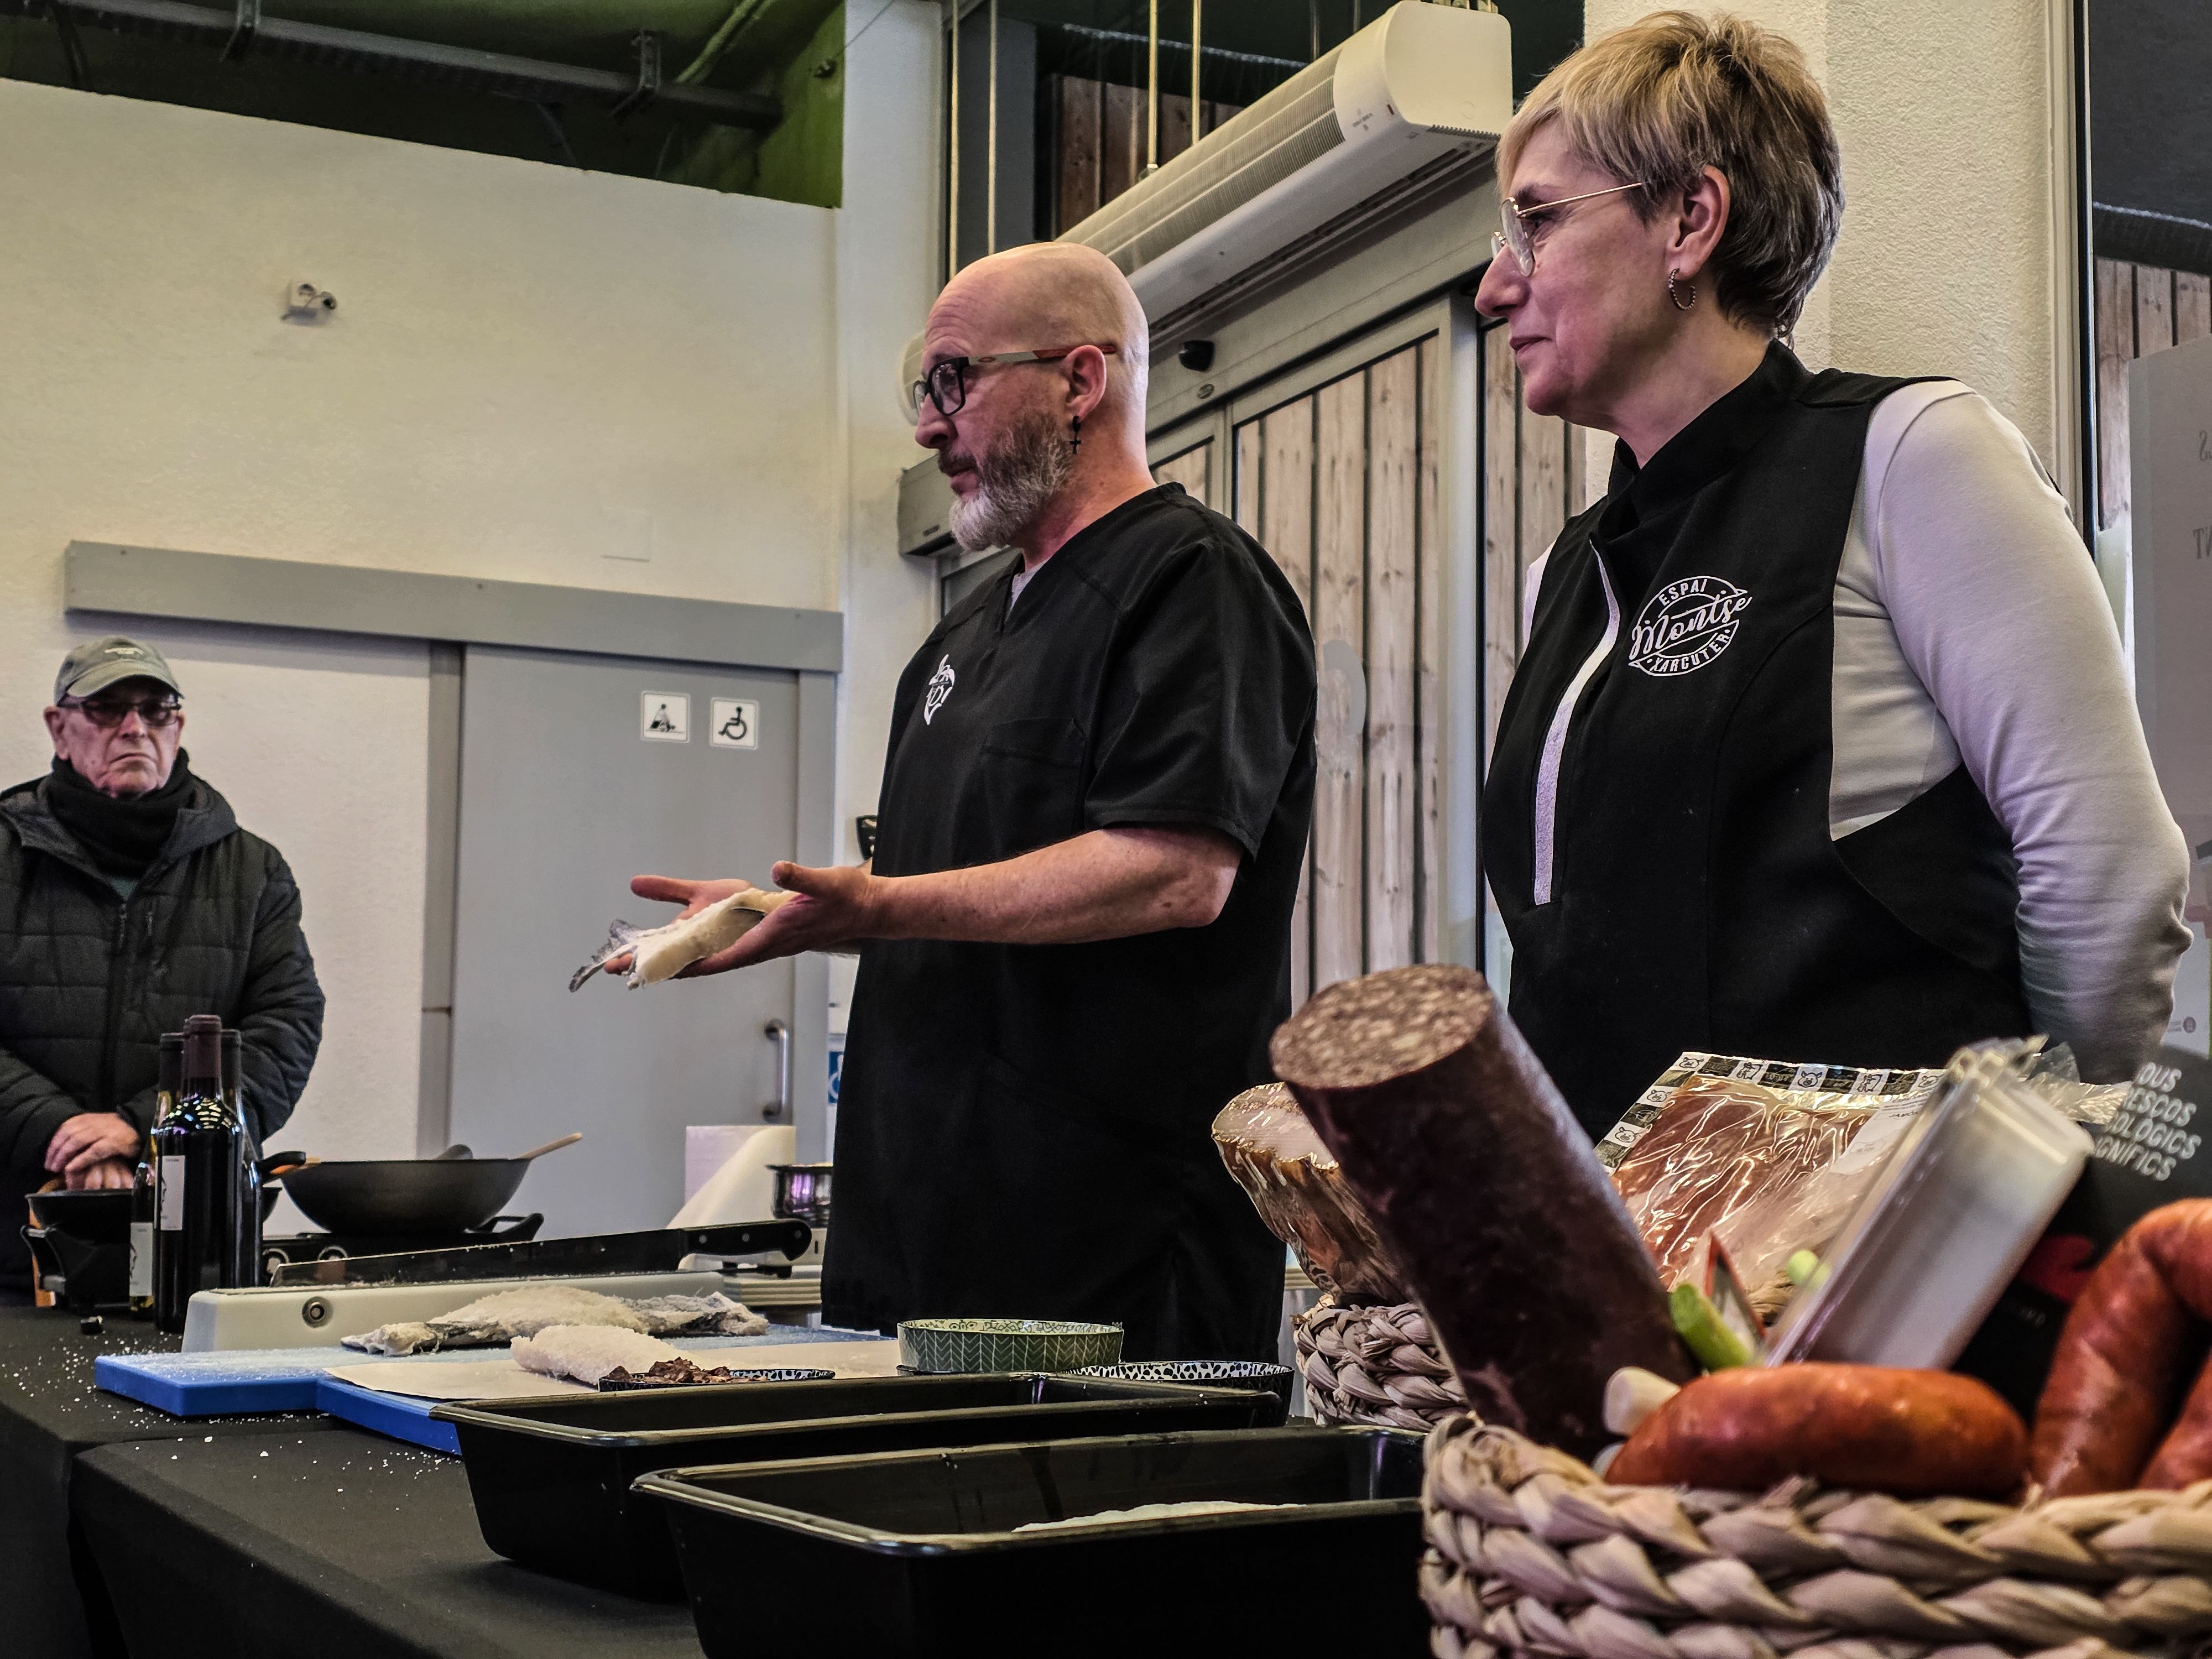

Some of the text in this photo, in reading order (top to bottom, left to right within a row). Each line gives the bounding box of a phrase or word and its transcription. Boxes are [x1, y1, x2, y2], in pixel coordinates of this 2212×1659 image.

[1659, 578, 1708, 606] ESPAI
[1629, 593, 1752, 659] Montse
[1650, 633, 1730, 672] XARCUTER
